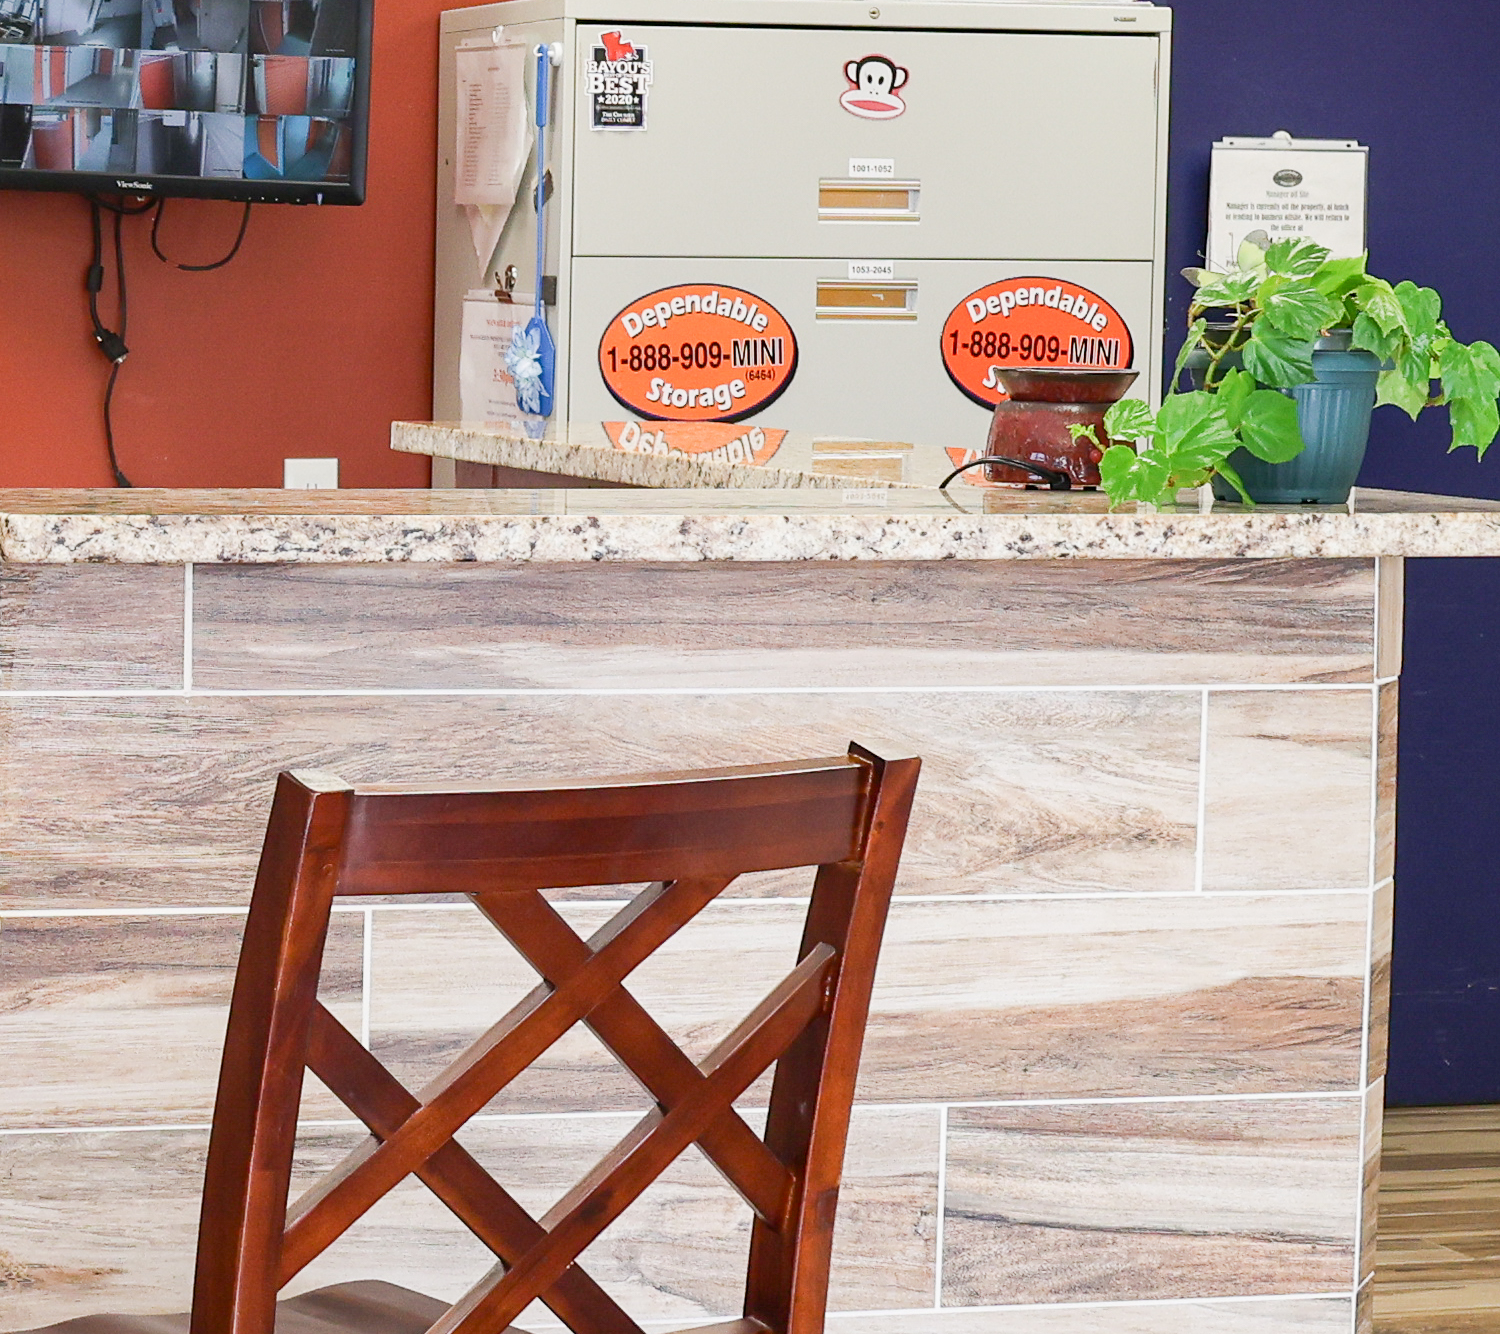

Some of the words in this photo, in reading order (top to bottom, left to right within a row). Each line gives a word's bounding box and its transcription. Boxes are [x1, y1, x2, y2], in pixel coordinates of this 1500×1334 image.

[587, 60, 652, 74] BAYOU'S
[587, 73, 650, 95] BEST
[604, 94, 633, 105] 2020
[852, 165, 892, 173] 1001-1052
[852, 266, 892, 274] 1053-2045
[621, 290, 769, 339] Dependable
[965, 285, 1108, 332] Dependable
[607, 337, 785, 373] 1-888-909-MINI
[949, 329, 1121, 367] 1-888-909-MINI
[745, 368, 776, 382] (6464)
[645, 377, 746, 411] Storage
